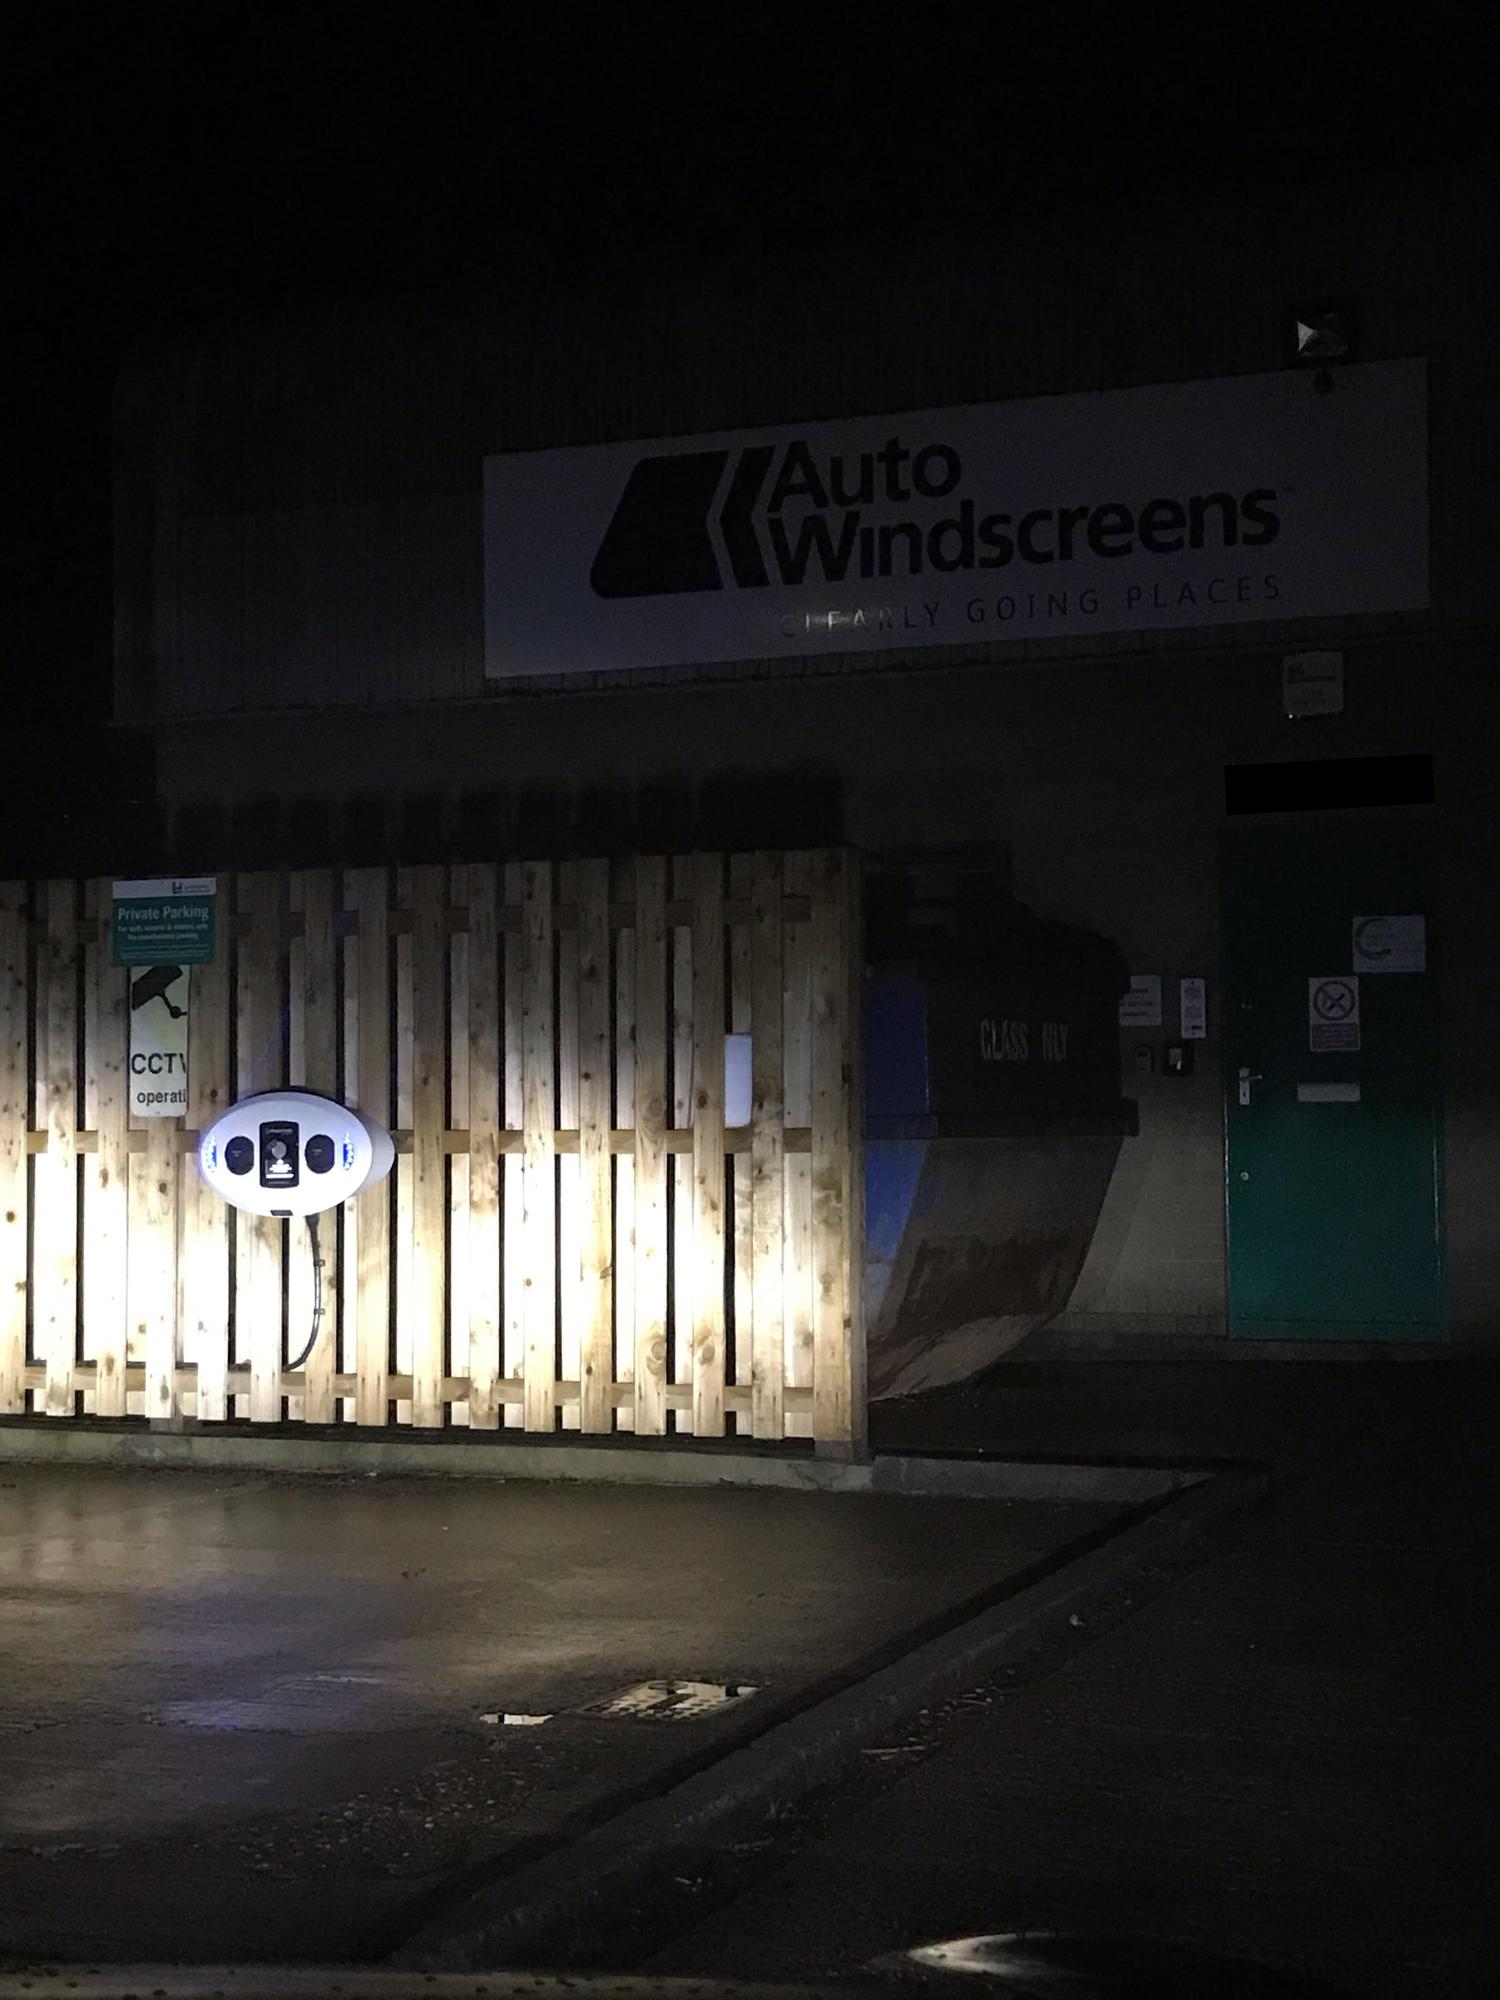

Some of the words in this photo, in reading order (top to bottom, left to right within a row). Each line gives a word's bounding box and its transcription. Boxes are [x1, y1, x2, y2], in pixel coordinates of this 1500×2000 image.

[767, 437, 962, 512] Auto
[767, 488, 1281, 585] Windscreens
[967, 588, 1099, 623] GOING
[1126, 574, 1280, 610] PLACES
[117, 907, 160, 920] Private
[162, 904, 209, 921] Parking
[1037, 1020, 1069, 1062] NLY
